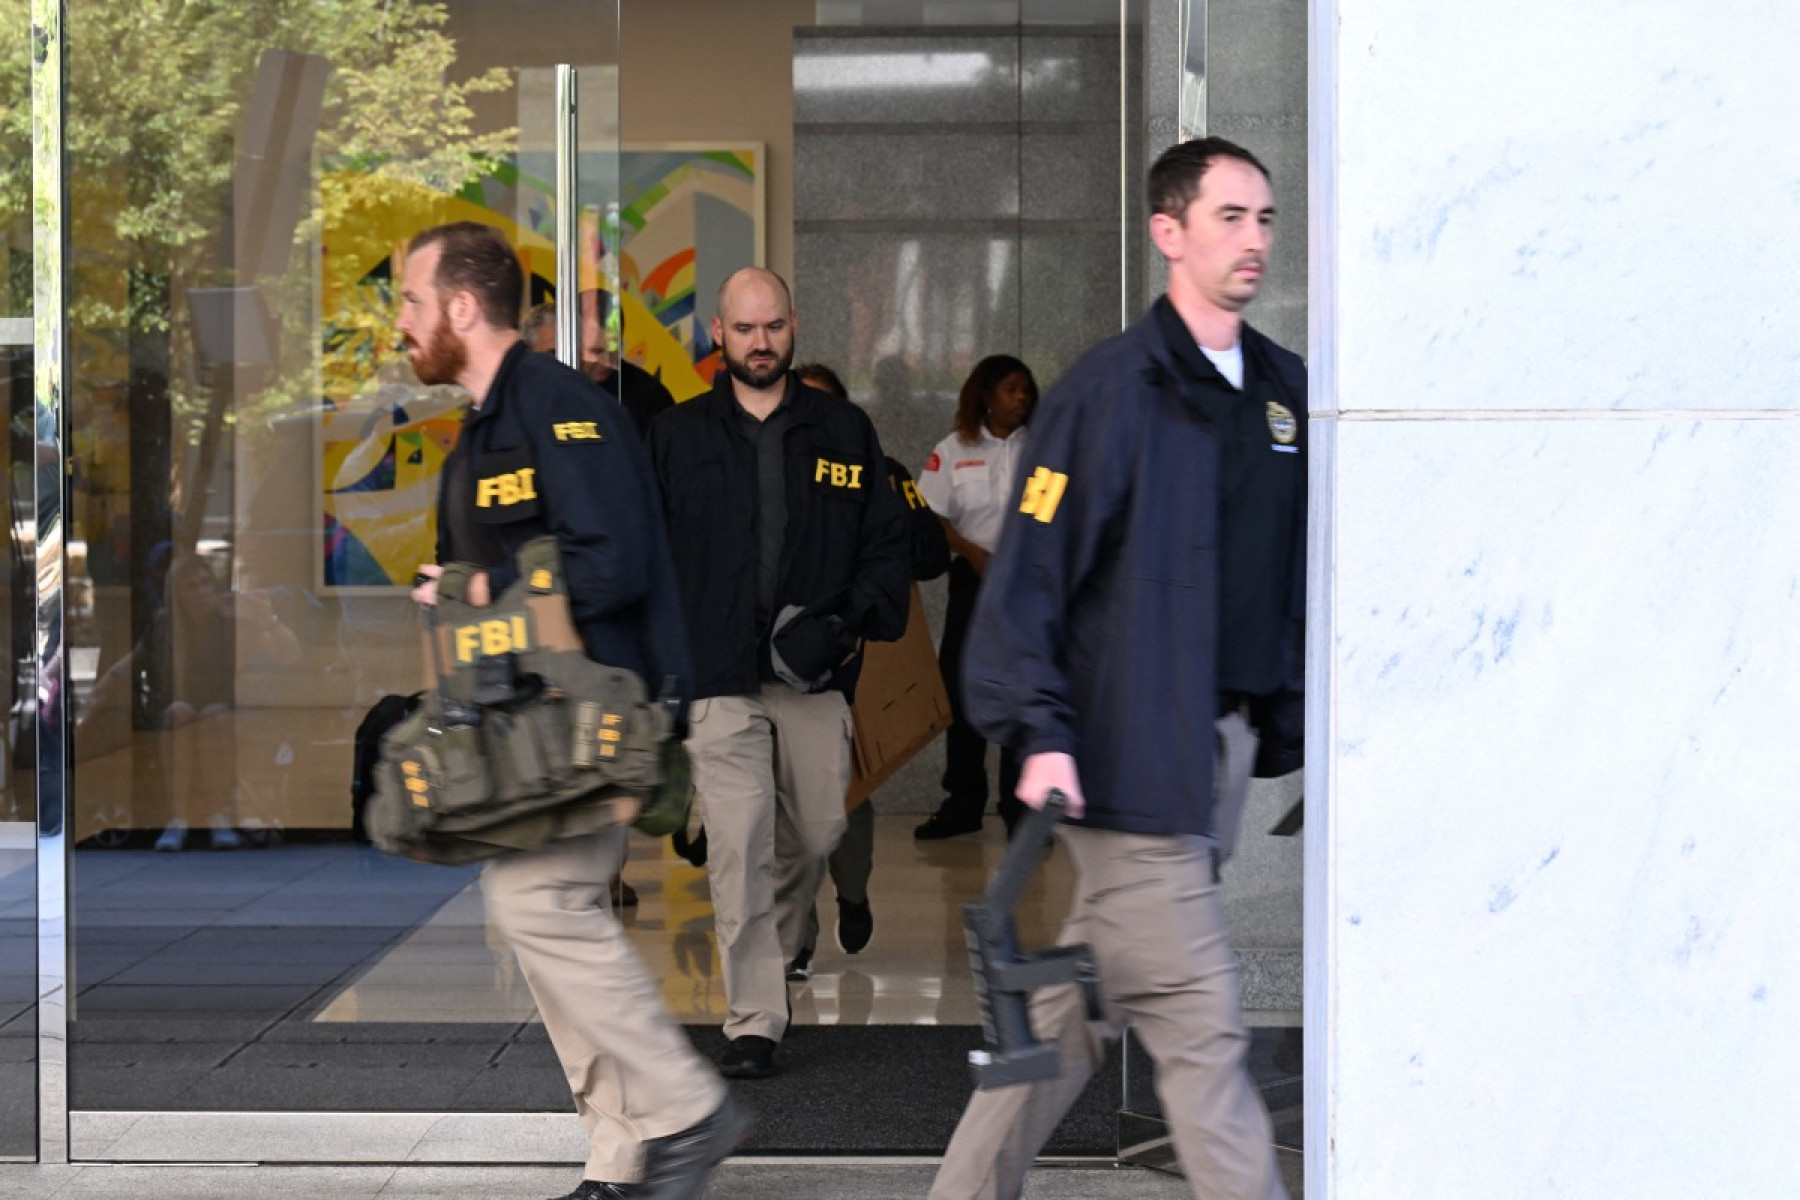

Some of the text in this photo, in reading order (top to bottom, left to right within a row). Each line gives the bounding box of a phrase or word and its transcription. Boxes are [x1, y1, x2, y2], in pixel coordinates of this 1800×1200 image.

[552, 422, 602, 440] FBI
[476, 468, 537, 507] FBI
[815, 458, 863, 488] FBI
[456, 616, 528, 662] FBI
